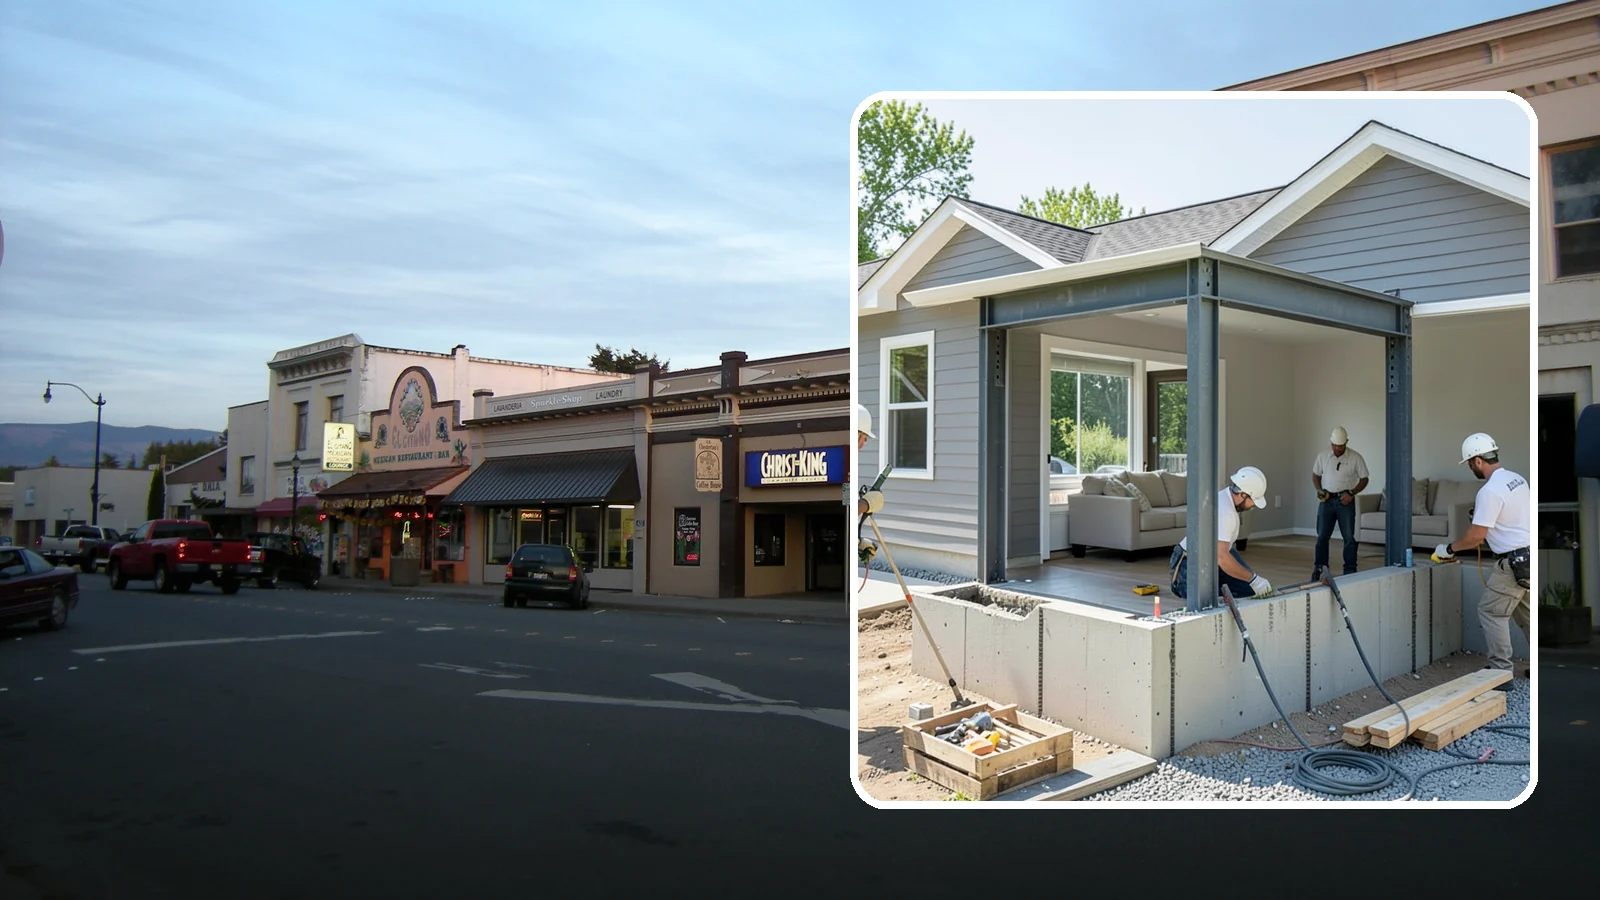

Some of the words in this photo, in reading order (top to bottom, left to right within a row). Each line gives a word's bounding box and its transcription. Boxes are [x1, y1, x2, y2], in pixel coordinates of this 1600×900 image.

[530, 398, 560, 409] Sparkle
[562, 394, 582, 404] Shop
[595, 389, 624, 400] LAUNDRY
[493, 402, 523, 413] LAVANDERIA
[373, 454, 396, 464] MEXICAN
[397, 451, 433, 463] RESTAURANT
[438, 450, 450, 459] BAR
[760, 451, 797, 478] CHRIST
[799, 450, 827, 476] KING
